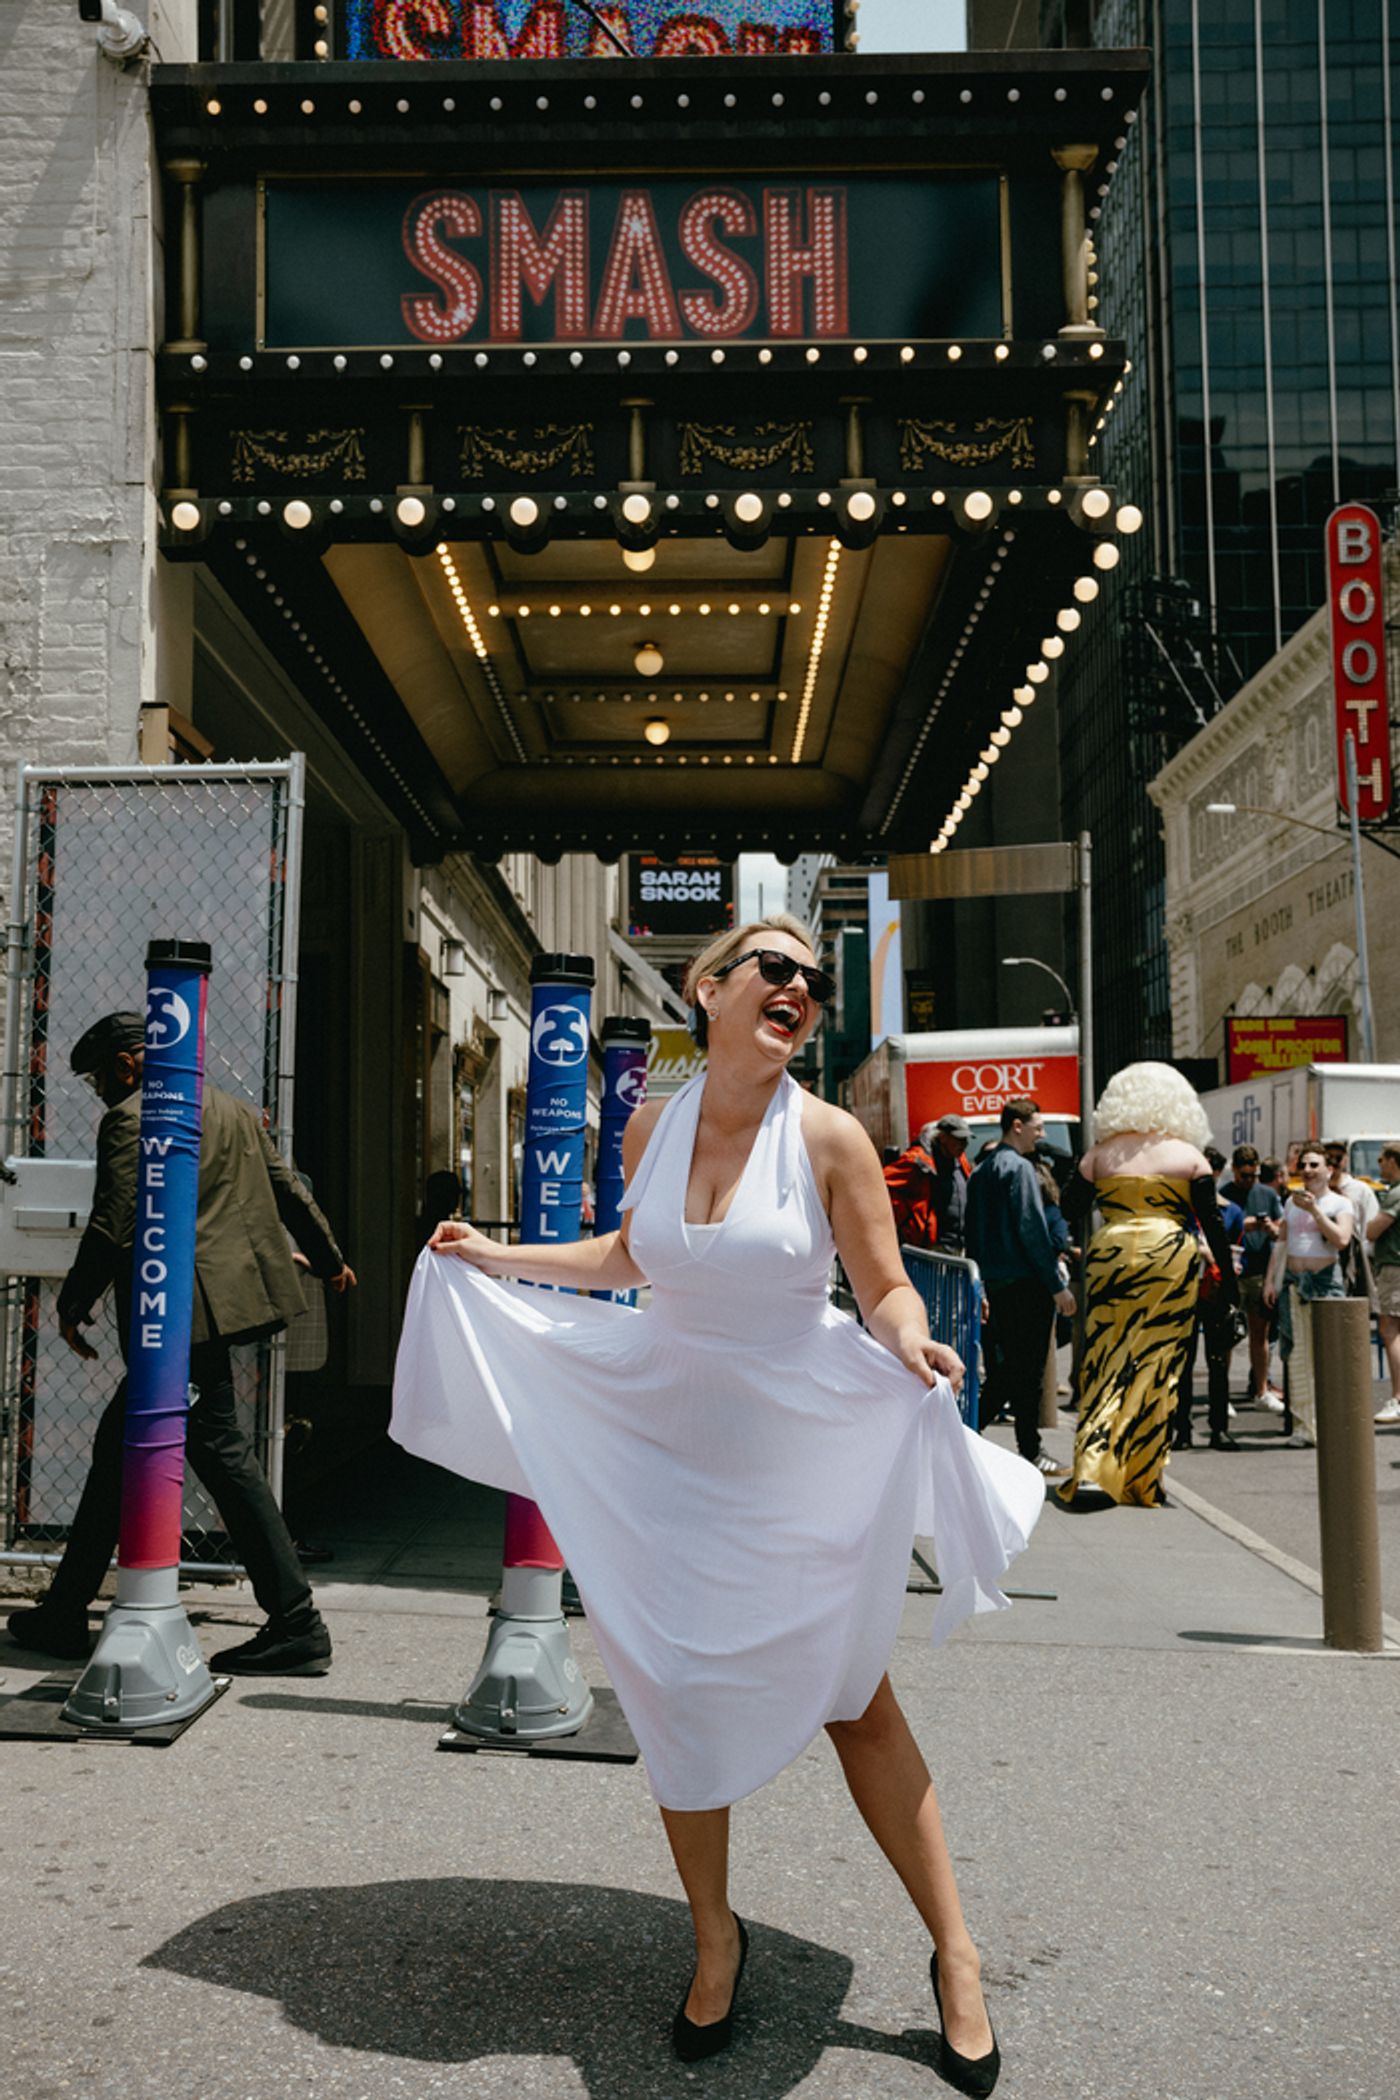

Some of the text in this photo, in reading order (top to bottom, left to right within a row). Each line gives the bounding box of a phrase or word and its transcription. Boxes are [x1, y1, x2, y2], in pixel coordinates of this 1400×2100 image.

[402, 187, 849, 343] SMASH
[1336, 519, 1383, 803] BOOTH
[640, 870, 721, 886] SARAH
[640, 886, 721, 902] SNOOK
[1226, 931, 1244, 960] THE
[1254, 905, 1293, 946] BOOTH
[148, 1080, 163, 1089] NO
[952, 1063, 1043, 1094] CORT
[532, 1108, 582, 1120] WEAPONS
[550, 1097, 568, 1107] NO
[963, 1094, 1031, 1112] EVEN
[1232, 1095, 1261, 1146] afr
[139, 1137, 173, 1348] WELCOME
